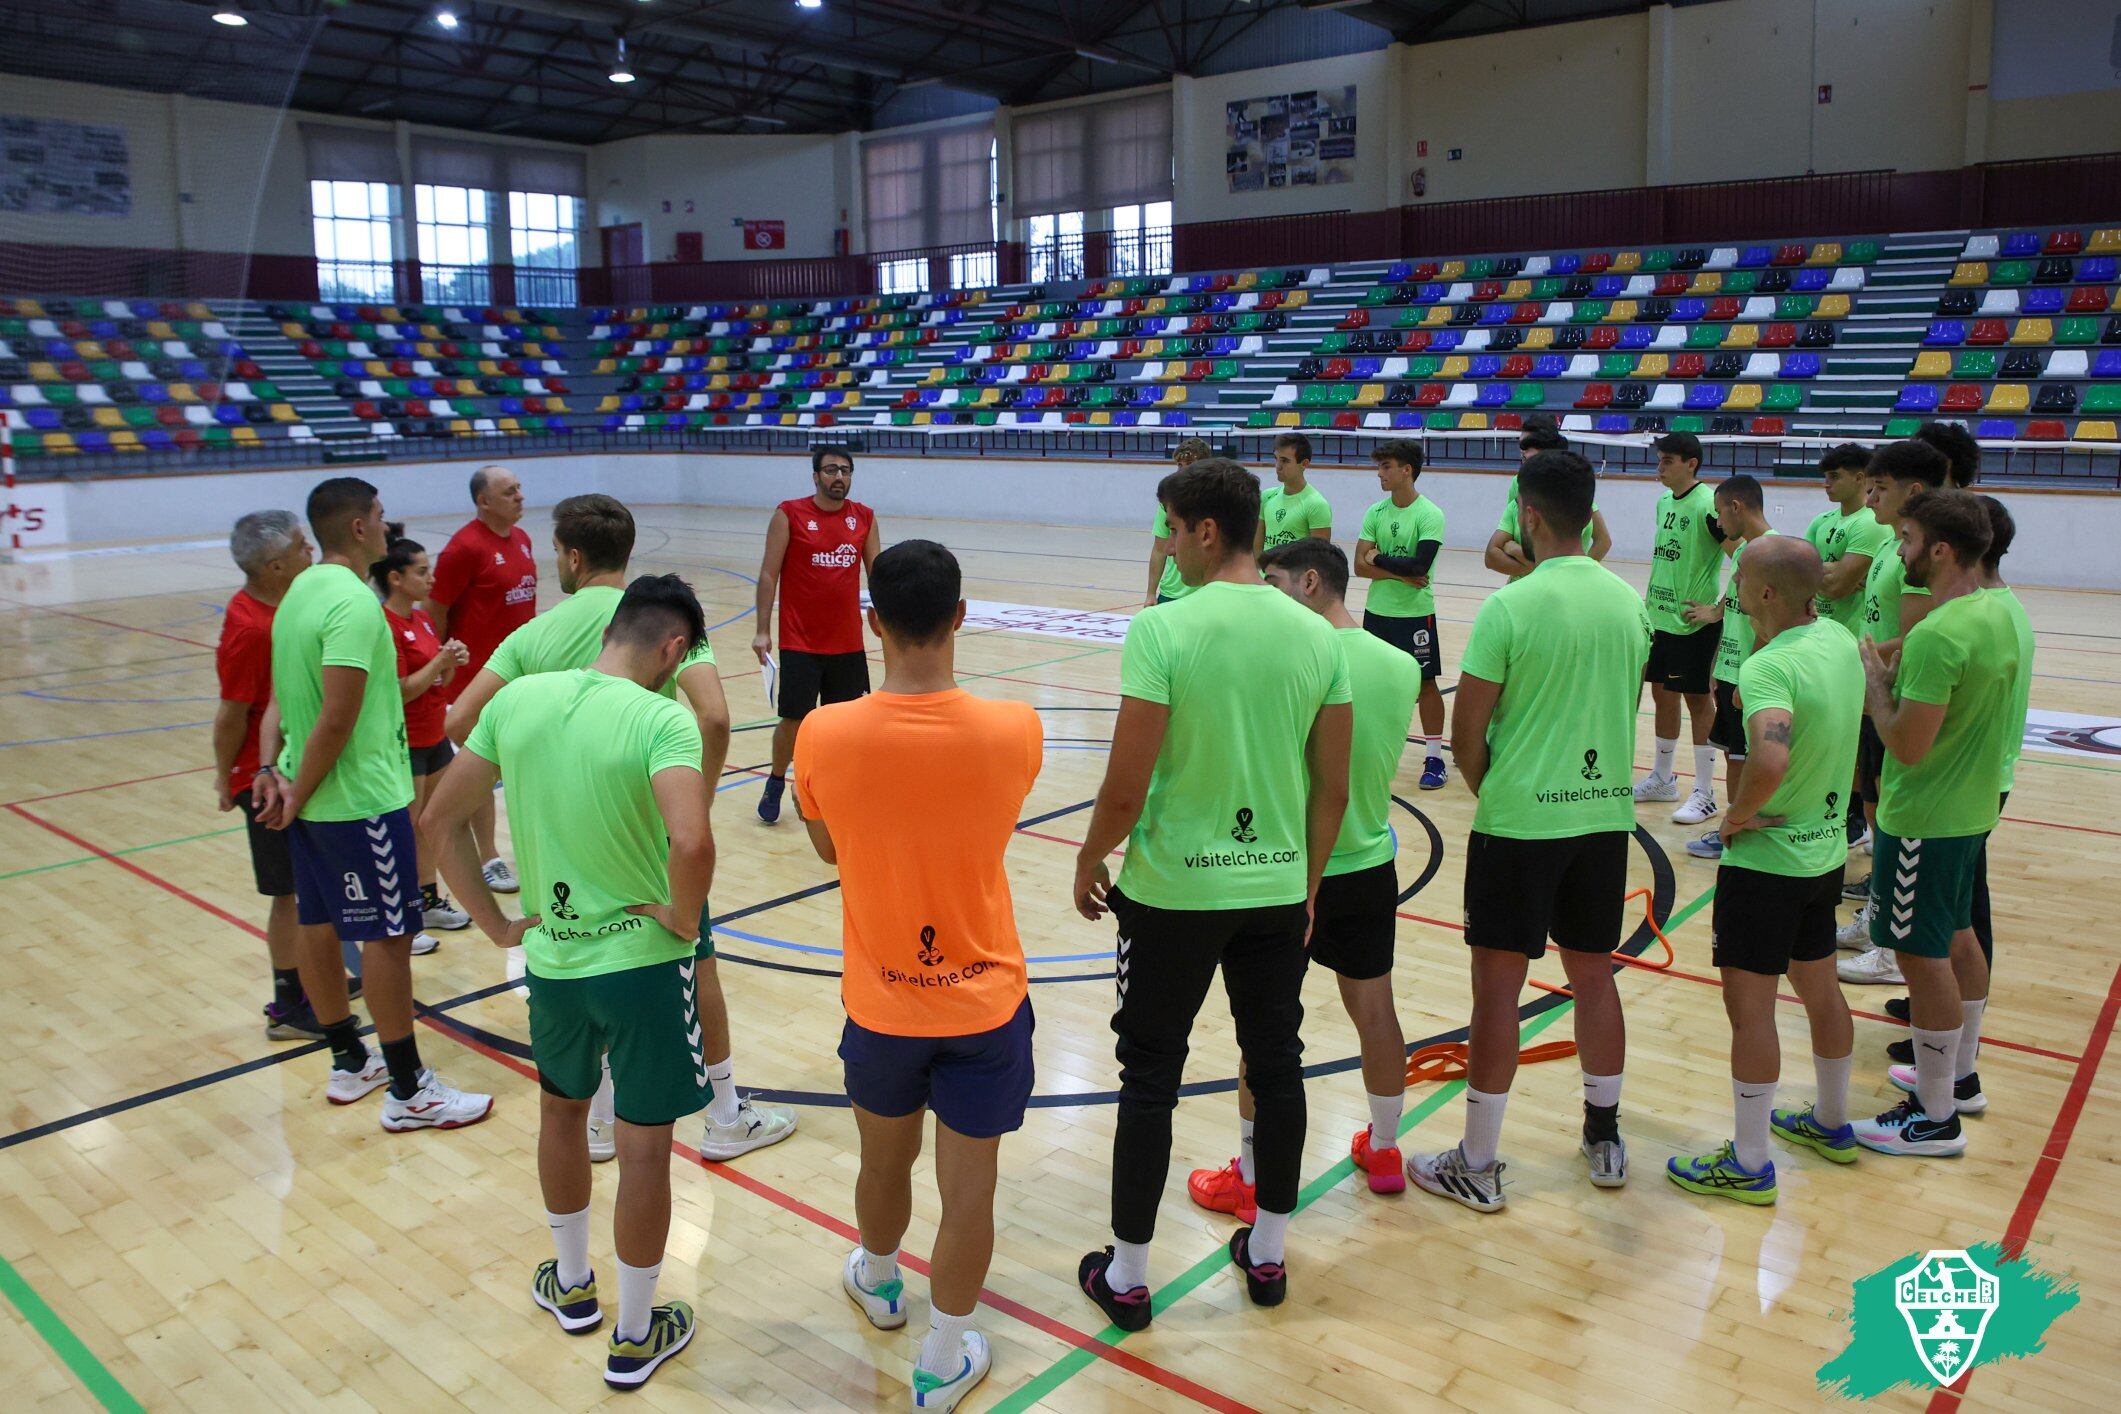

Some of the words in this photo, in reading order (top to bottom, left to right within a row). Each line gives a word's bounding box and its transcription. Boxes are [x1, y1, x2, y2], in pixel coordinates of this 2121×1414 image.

[1664, 511, 1676, 530] 22
[811, 551, 857, 568] atticgo
[1536, 786, 1633, 803] visitelche.co
